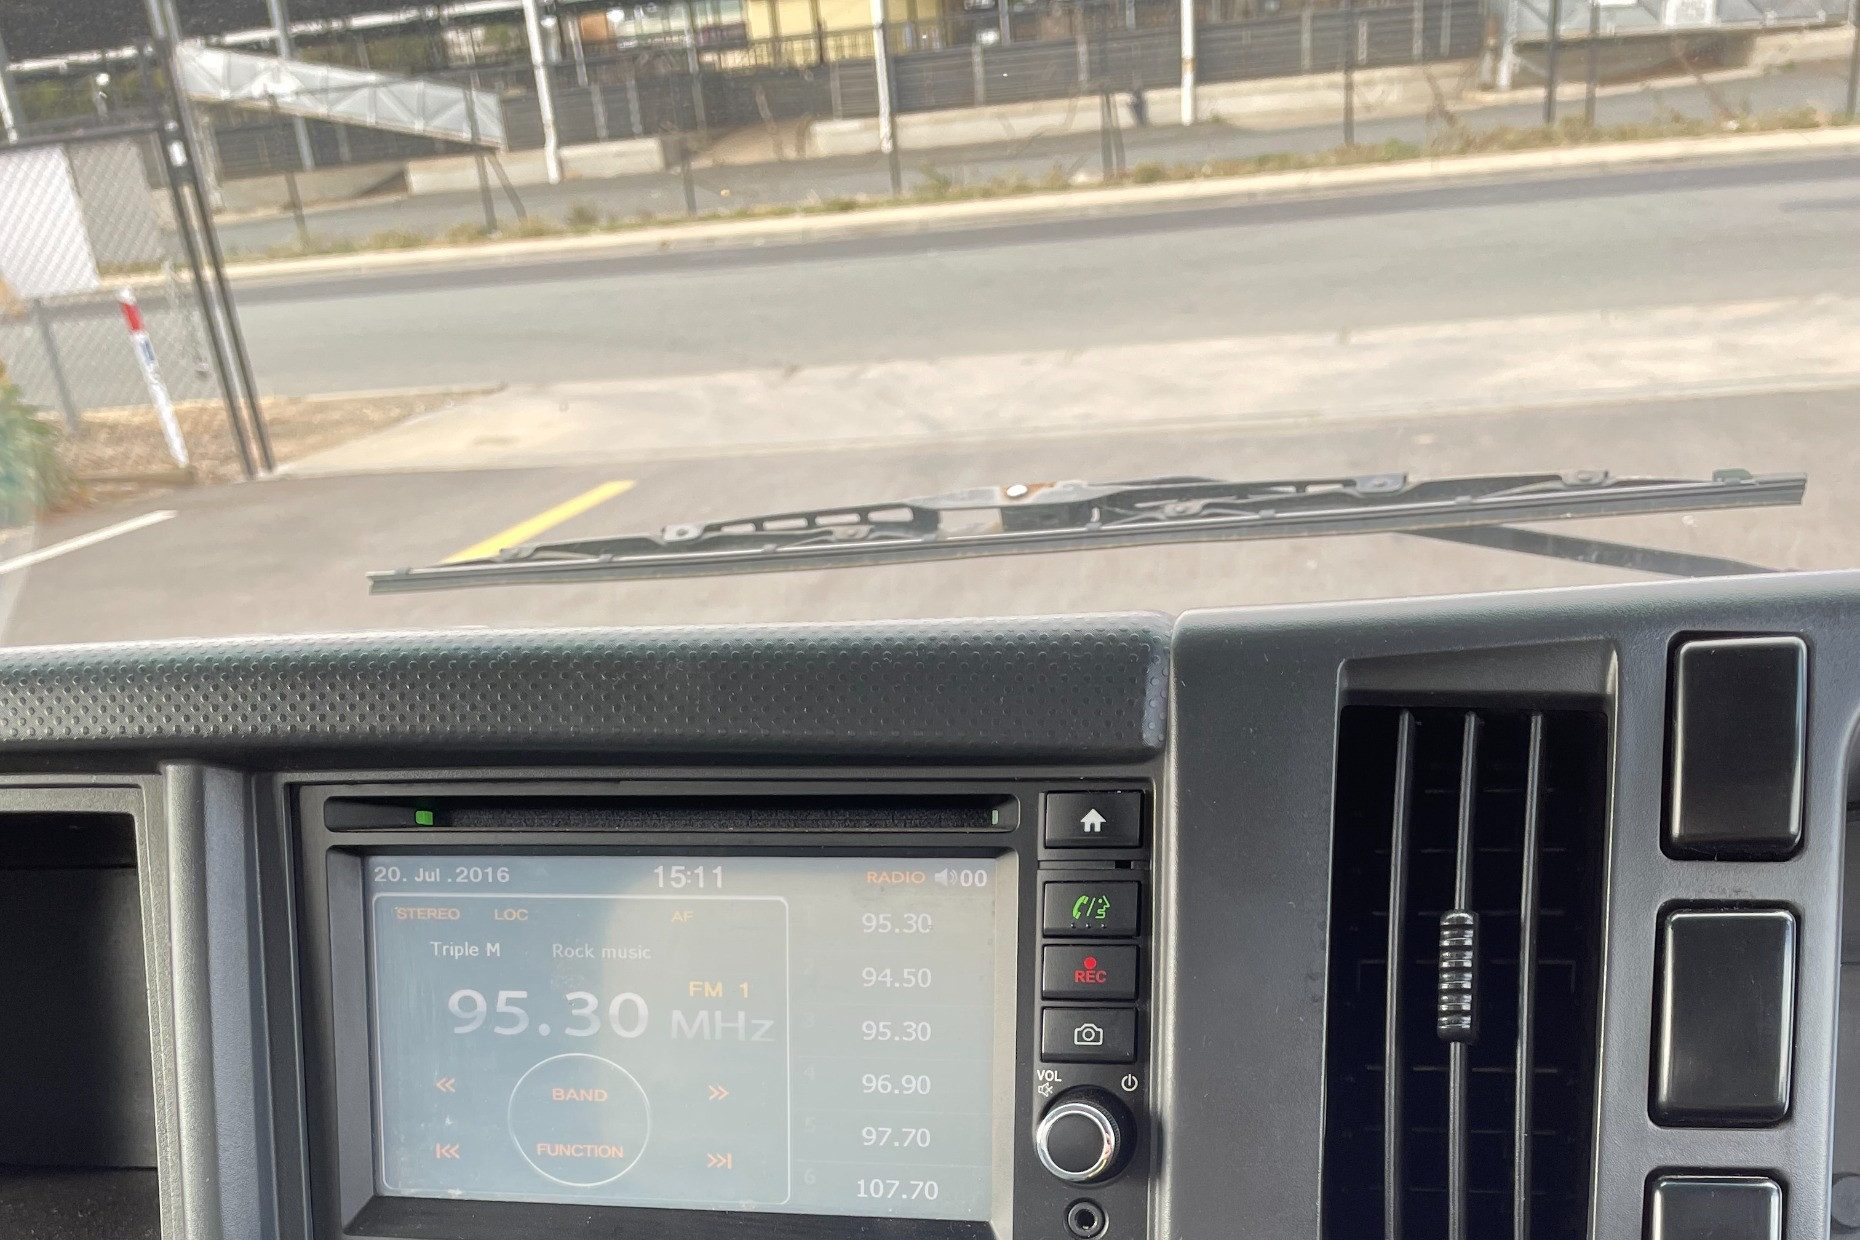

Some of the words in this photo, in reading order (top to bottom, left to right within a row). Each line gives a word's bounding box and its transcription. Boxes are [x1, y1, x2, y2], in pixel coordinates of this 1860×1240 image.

[373, 866, 408, 883] 20.
[414, 868, 441, 883] Jul
[653, 865, 723, 889] 15:11
[866, 870, 927, 885] RADIO
[959, 869, 988, 887] 00
[395, 907, 461, 921] STEREO
[493, 908, 529, 922] LOC
[671, 910, 694, 923] AF
[861, 912, 933, 935] 95.30
[429, 941, 480, 958] Triple
[486, 942, 501, 957] M
[551, 943, 595, 959] Rock
[601, 944, 652, 960] music
[861, 966, 932, 989] 94.50
[1073, 969, 1108, 984] REC
[688, 980, 724, 998] FM
[739, 981, 750, 999] 1
[448, 988, 649, 1039] 95.30
[670, 1009, 776, 1043] MHz
[861, 1020, 932, 1043] 95.30
[861, 1073, 932, 1095] 96.90
[1036, 1069, 1063, 1083] VOL
[551, 1087, 608, 1103] BAND
[861, 1126, 932, 1148] 97.70
[536, 1142, 624, 1159] FUNCTION
[856, 1178, 939, 1200] 107.70
